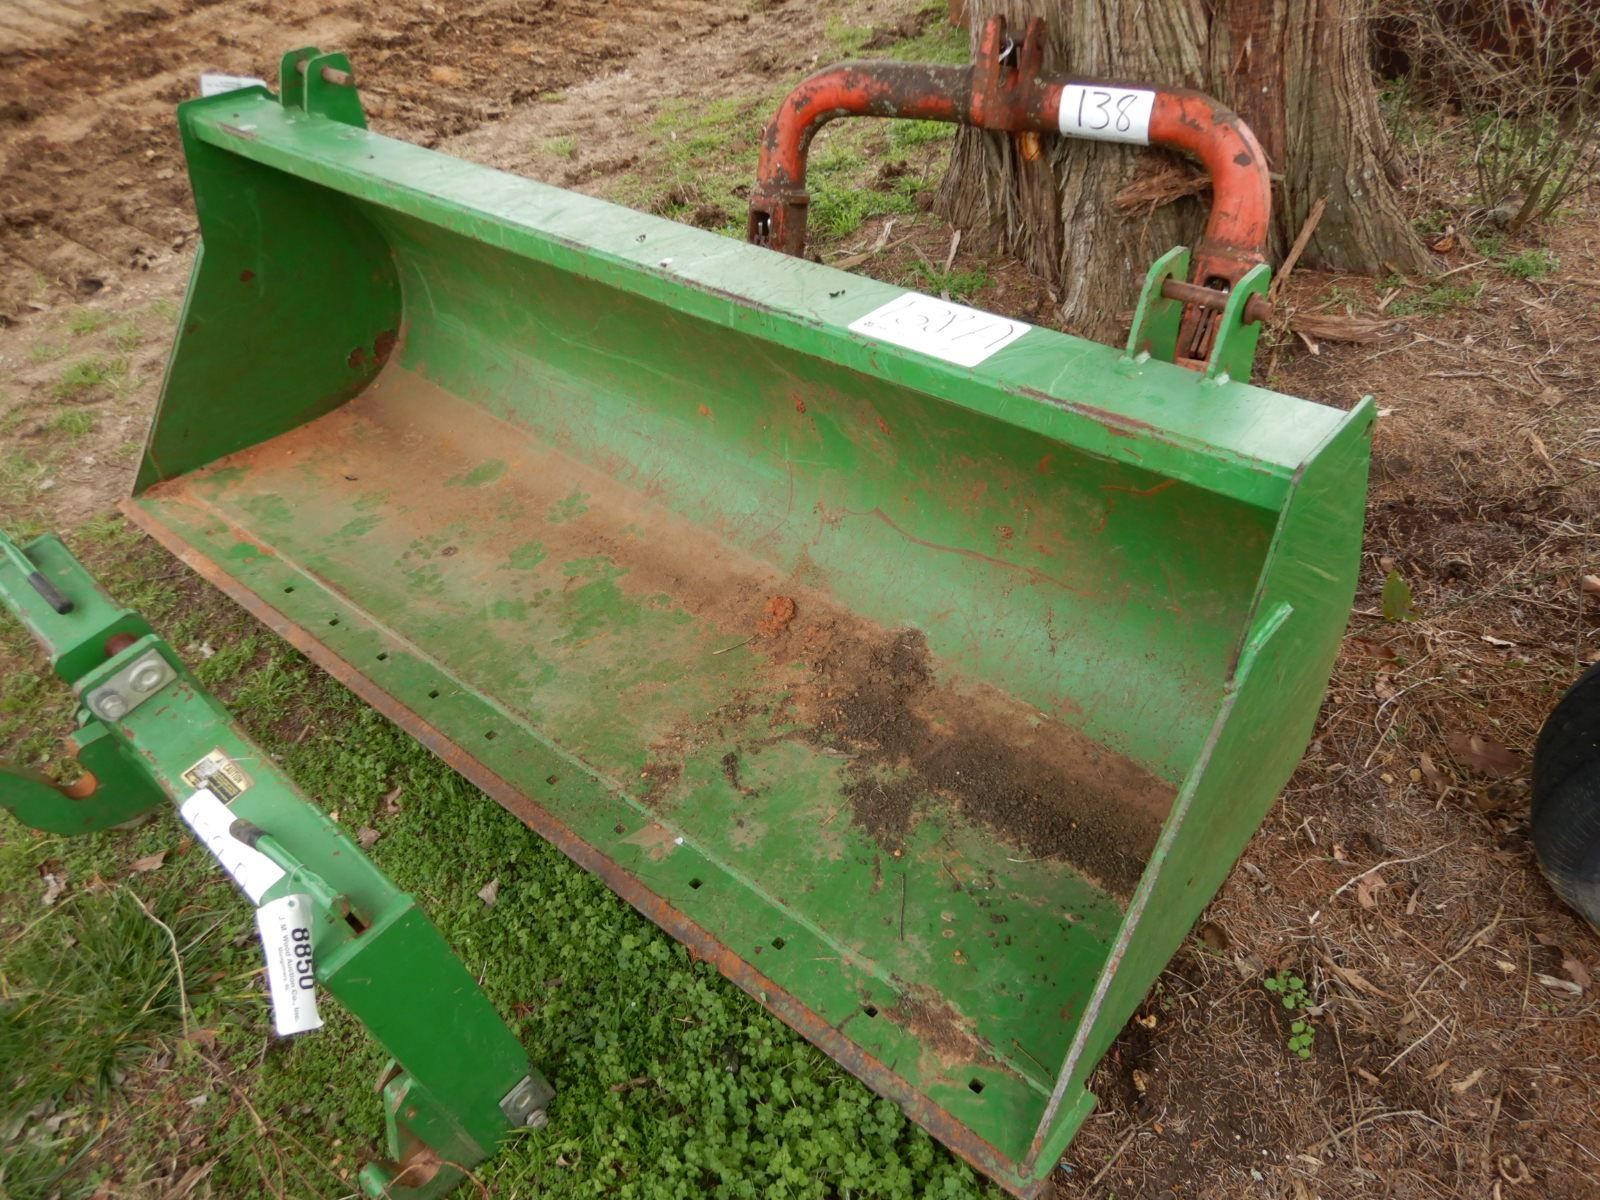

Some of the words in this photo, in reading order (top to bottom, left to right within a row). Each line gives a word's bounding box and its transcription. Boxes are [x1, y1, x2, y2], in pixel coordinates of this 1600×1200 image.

[1078, 88, 1138, 132] 138
[283, 935, 291, 957] Wood
[287, 958, 296, 988] Auction
[291, 928, 314, 990] 8850
